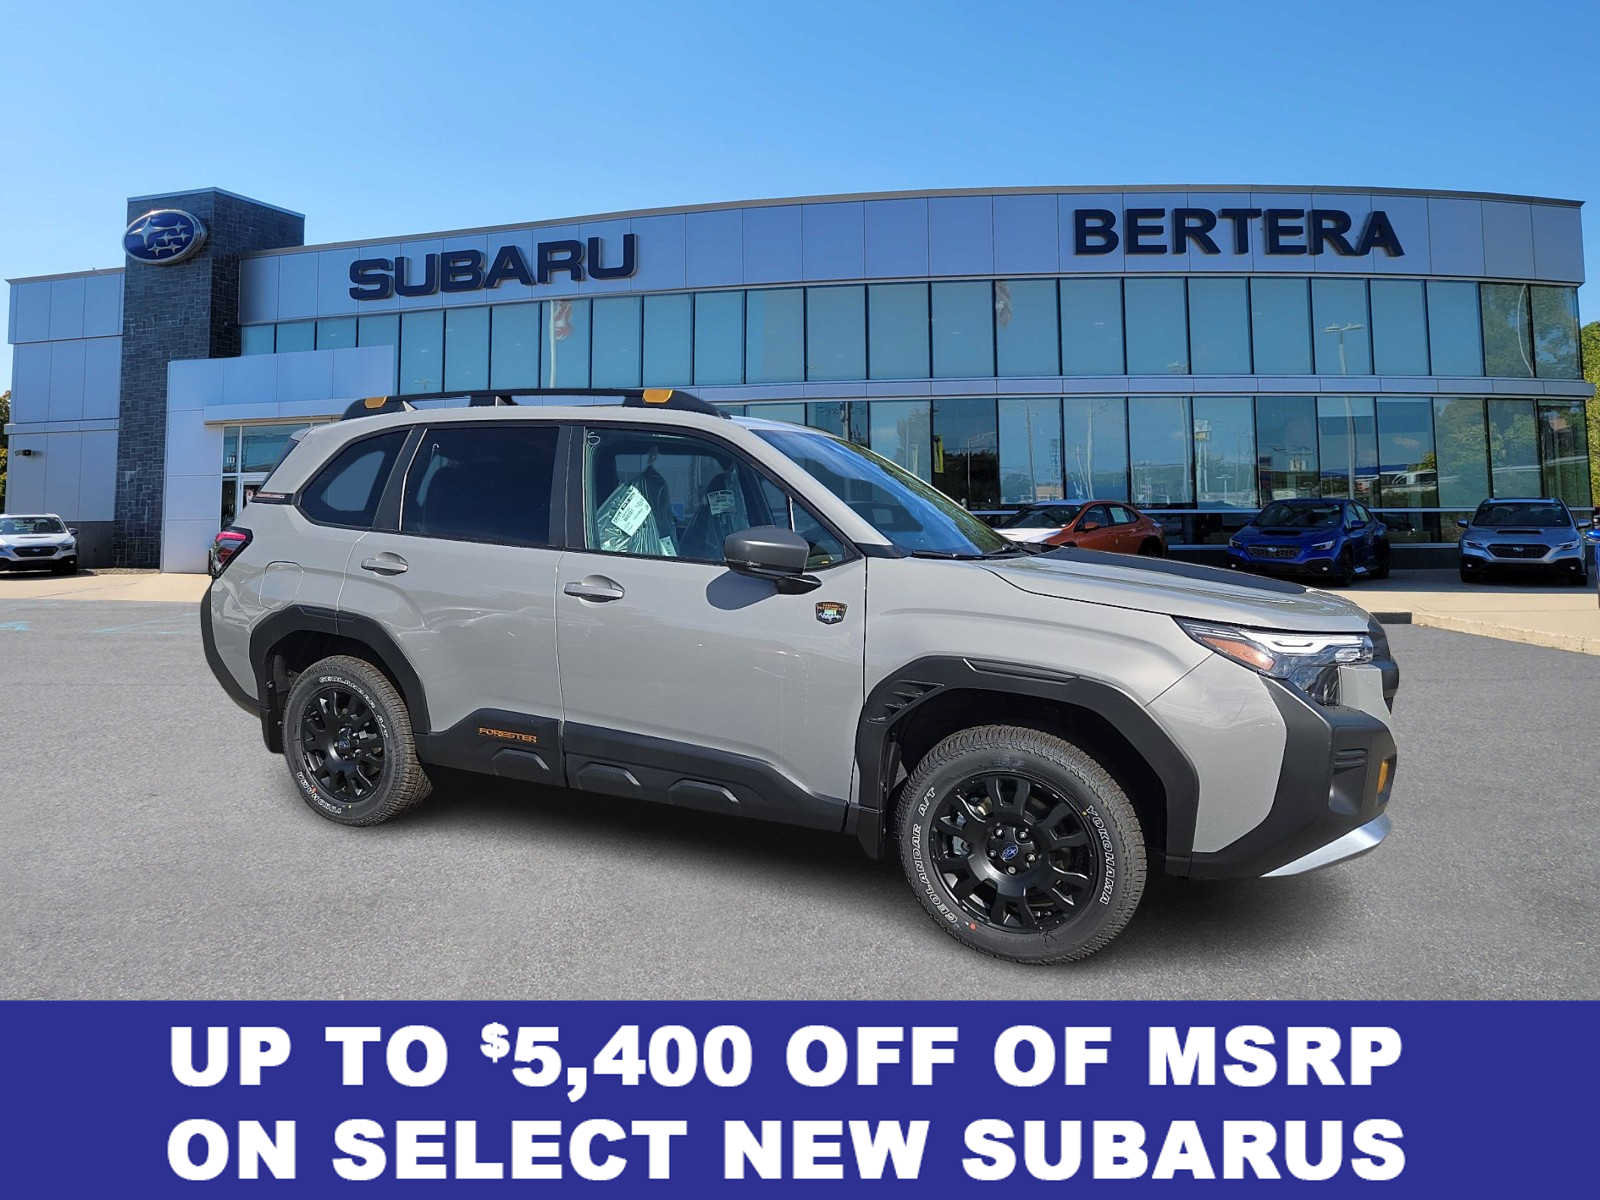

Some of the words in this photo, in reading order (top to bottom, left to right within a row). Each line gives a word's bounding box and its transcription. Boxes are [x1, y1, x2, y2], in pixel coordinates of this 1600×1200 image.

[1074, 208, 1405, 257] BERTERA
[349, 233, 638, 300] SUBARU
[478, 727, 537, 743] FORESTER
[918, 787, 936, 816] A/T
[912, 824, 957, 922] GEOLANDAR
[1086, 805, 1115, 904] YOKOHAMA
